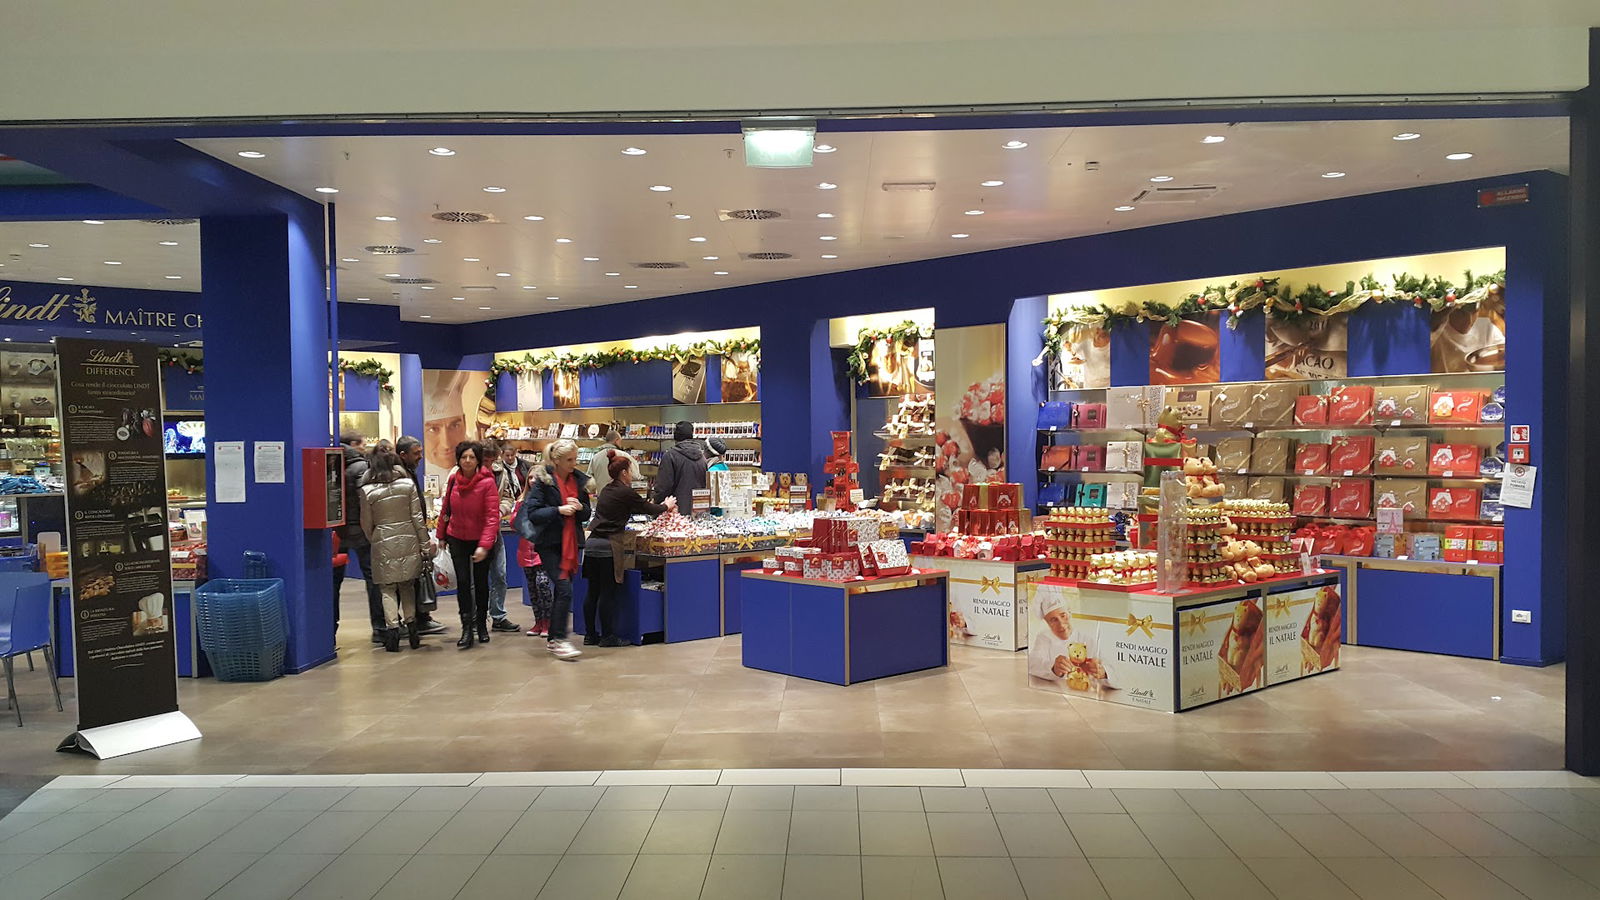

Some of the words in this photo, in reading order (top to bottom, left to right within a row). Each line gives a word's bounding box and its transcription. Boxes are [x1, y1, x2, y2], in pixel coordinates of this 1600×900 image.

[105, 308, 176, 327] MAÎTRE
[86, 349, 124, 363] Lindt
[86, 367, 136, 376] DIFFERENCE
[974, 606, 980, 614] IL
[982, 607, 1010, 617] NATALE
[1269, 636, 1275, 645] IL
[1276, 632, 1296, 643] NATALE
[1115, 641, 1136, 651] RENDI
[1138, 645, 1168, 655] MAGICO
[1117, 651, 1126, 662] IL
[1128, 653, 1167, 668] NATALE
[1182, 655, 1188, 665] IL
[1190, 650, 1213, 663] NATALE
